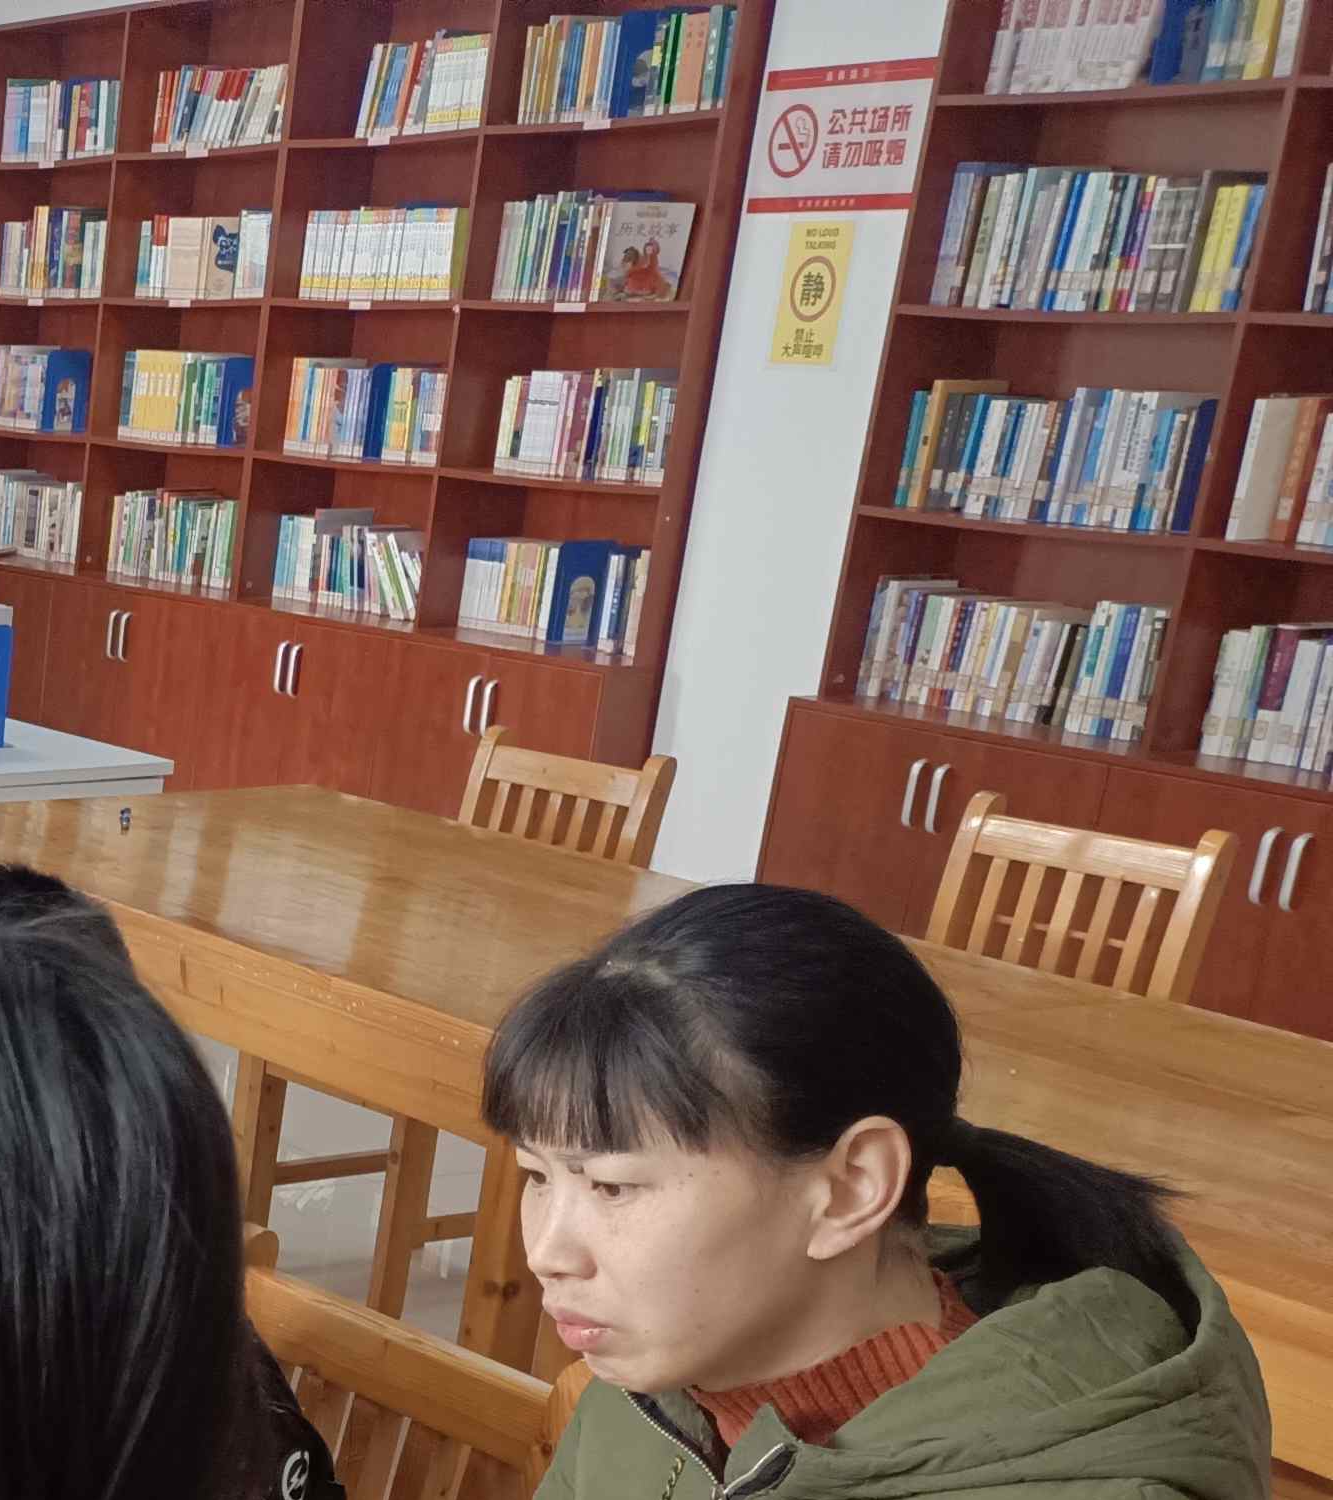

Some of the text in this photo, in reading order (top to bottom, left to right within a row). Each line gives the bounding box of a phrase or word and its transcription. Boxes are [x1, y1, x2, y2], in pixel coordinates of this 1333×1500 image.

[827, 104, 913, 135] 公共场所
[821, 139, 907, 168] 请勿吸烟
[614, 222, 678, 238] 历史故事
[800, 271, 825, 307] 静
[794, 328, 815, 343] 禁止
[781, 343, 824, 358] 大声喧哗
